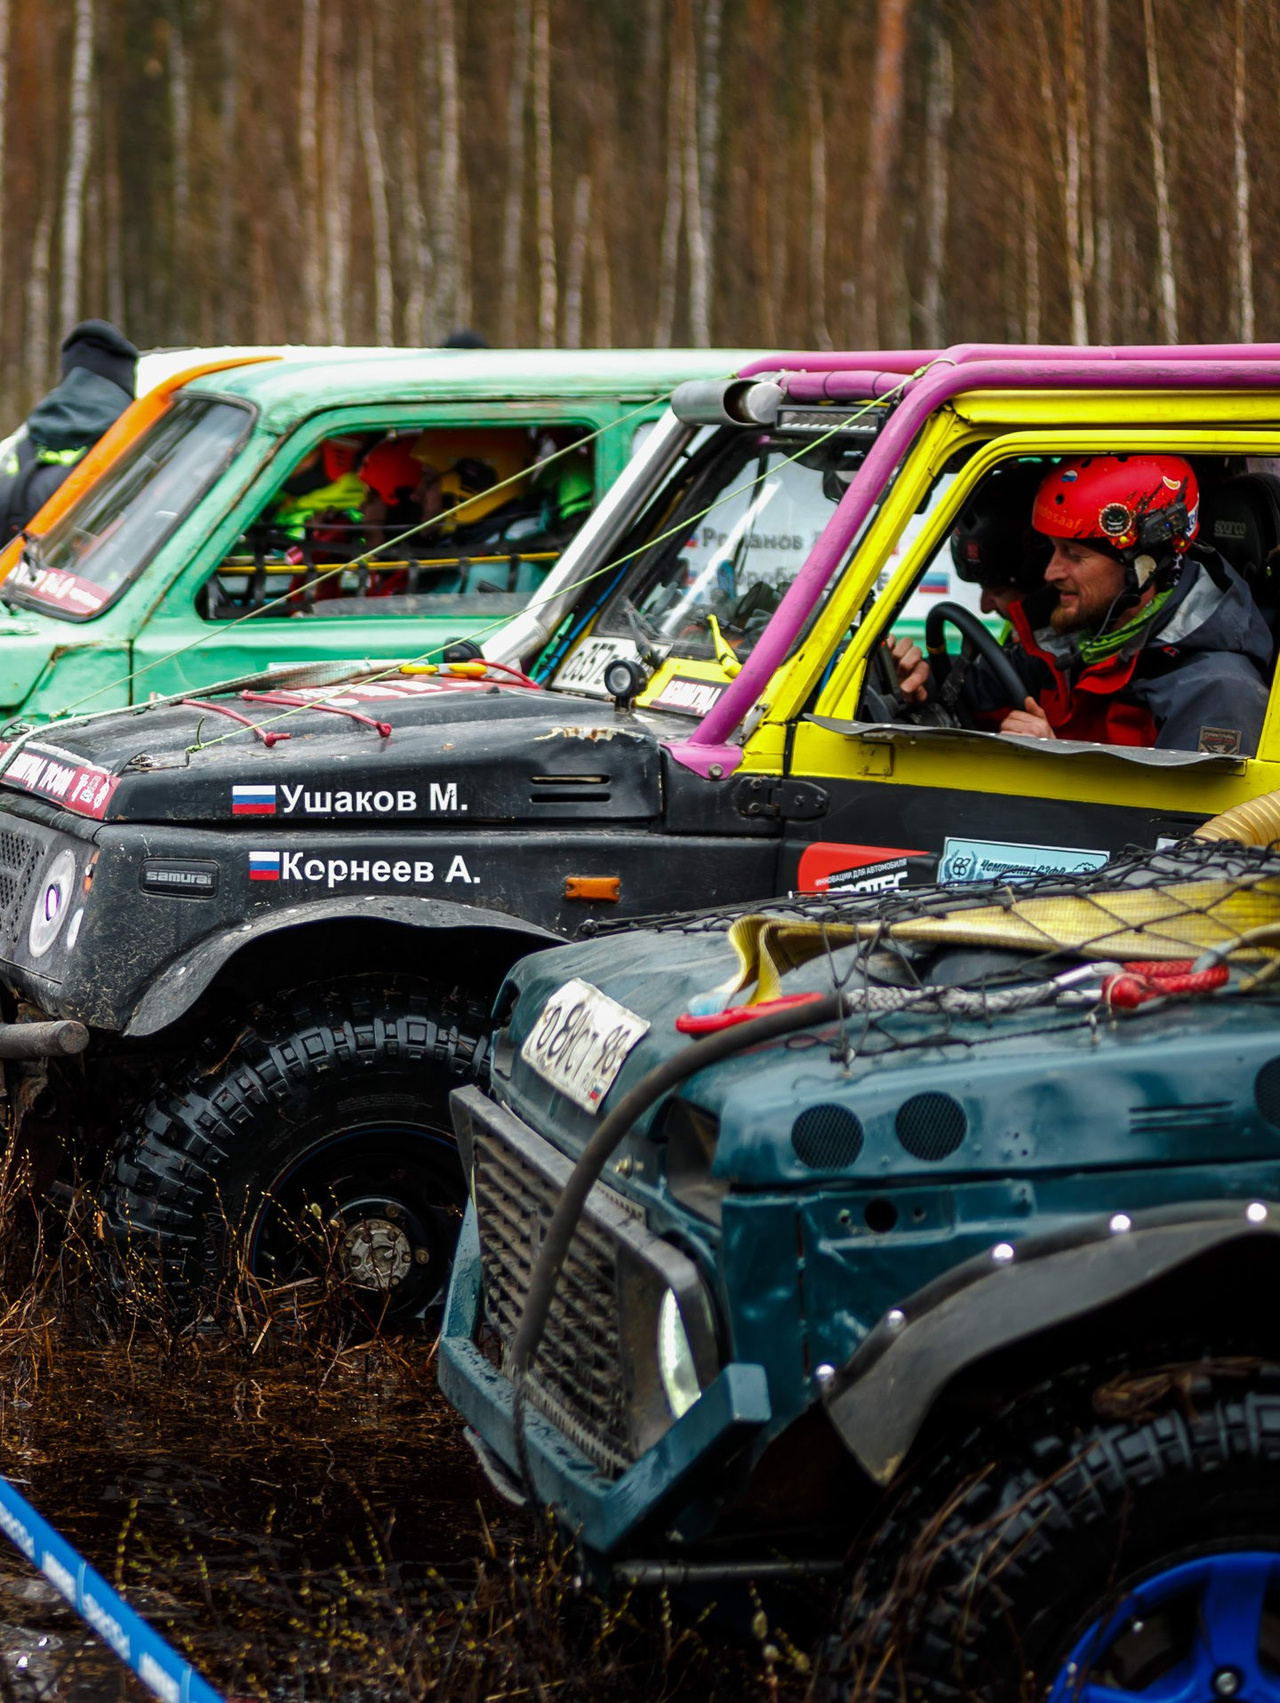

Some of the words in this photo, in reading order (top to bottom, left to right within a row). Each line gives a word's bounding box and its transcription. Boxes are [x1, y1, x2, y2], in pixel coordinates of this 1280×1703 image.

[280, 784, 417, 813] Ушаков
[429, 782, 468, 811] М.
[146, 871, 212, 885] samurai
[282, 851, 434, 888] Корнеев
[445, 855, 481, 884] А.
[852, 868, 867, 880] ДЛЯ
[866, 858, 908, 876] АВТОМОБИЛЯ
